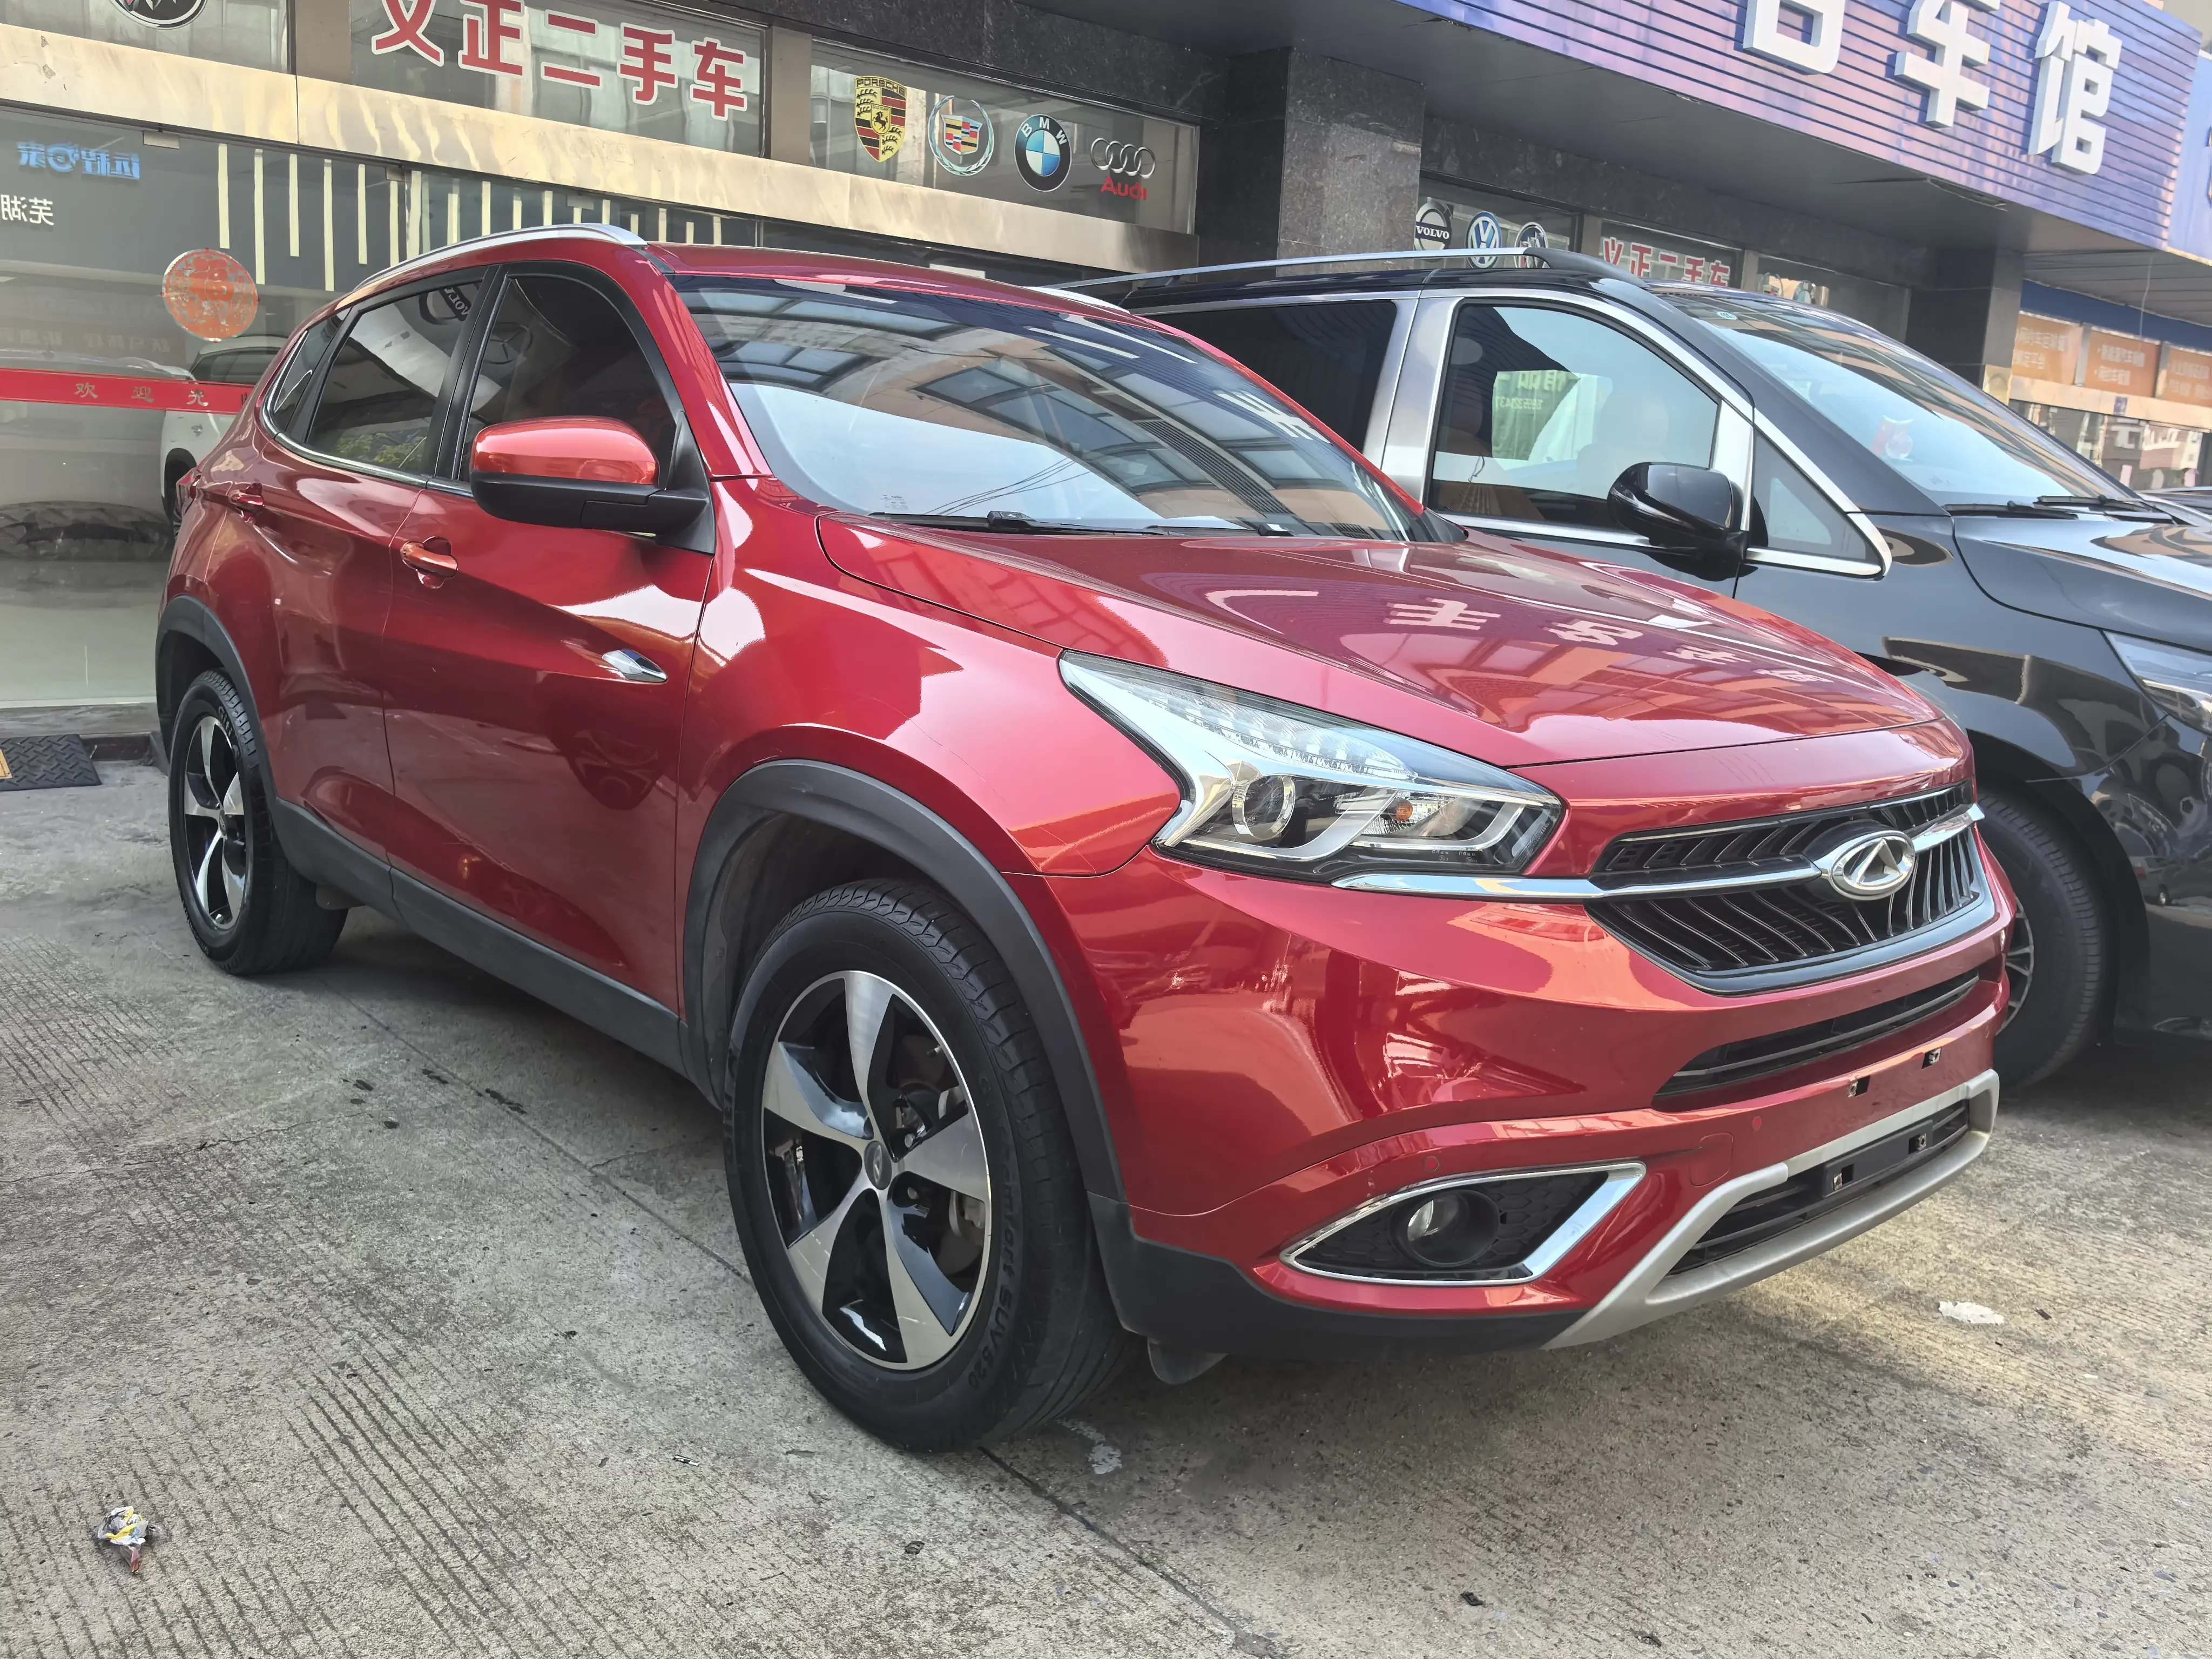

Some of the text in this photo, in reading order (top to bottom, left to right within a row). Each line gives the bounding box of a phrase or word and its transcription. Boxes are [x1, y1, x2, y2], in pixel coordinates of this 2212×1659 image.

[857, 78, 906, 97] PORSCHE
[1020, 117, 1068, 146] BMW
[1415, 225, 1450, 240] VOLVO
[74, 382, 249, 407] 欢迎光
